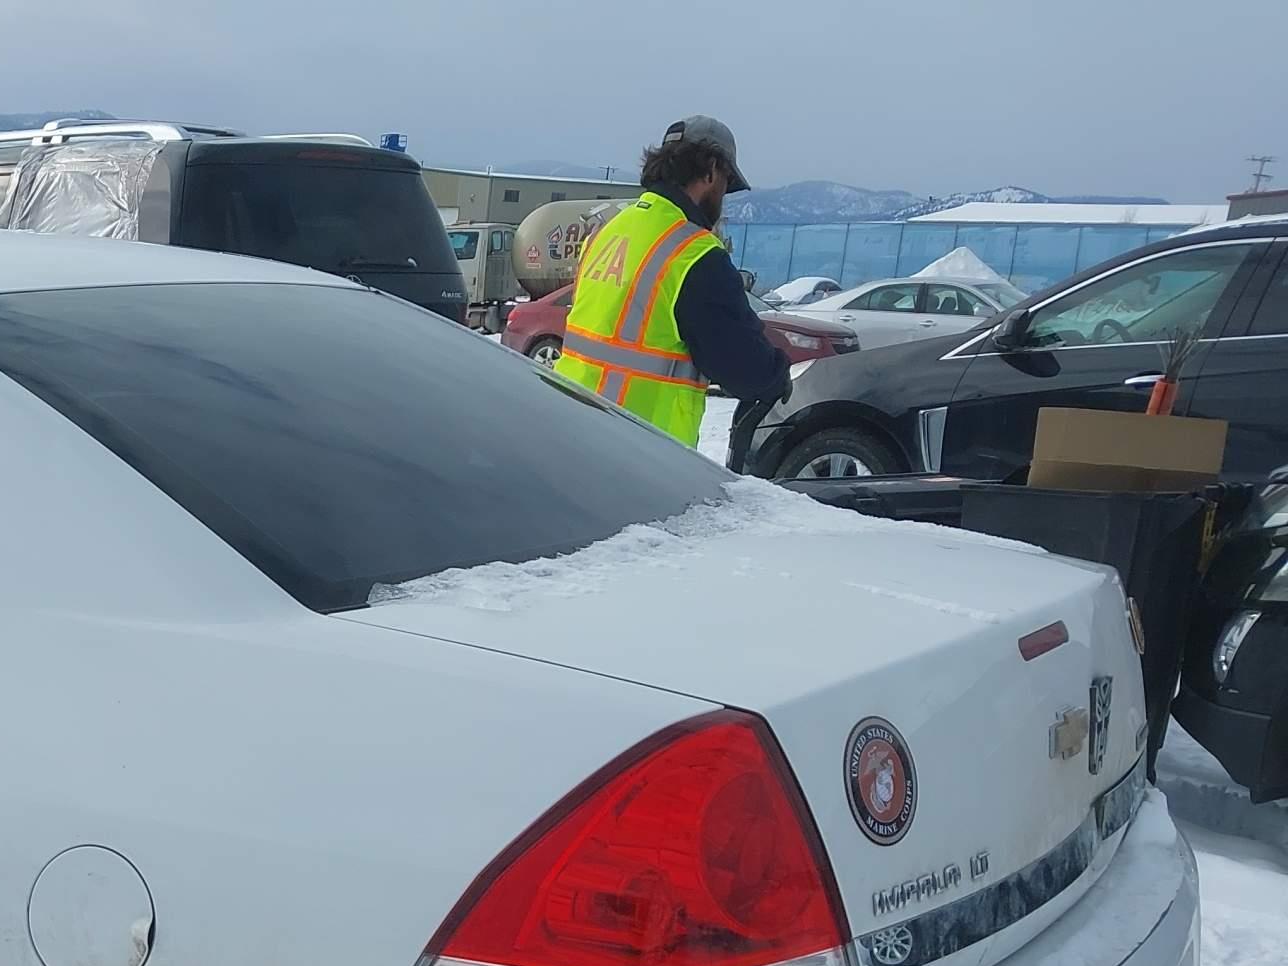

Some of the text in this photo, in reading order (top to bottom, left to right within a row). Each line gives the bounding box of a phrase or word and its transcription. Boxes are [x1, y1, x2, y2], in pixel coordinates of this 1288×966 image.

[852, 727, 893, 777] UNITED STATES
[866, 780, 912, 835] MARINE CORPS
[872, 850, 990, 917] IMPALA LT
